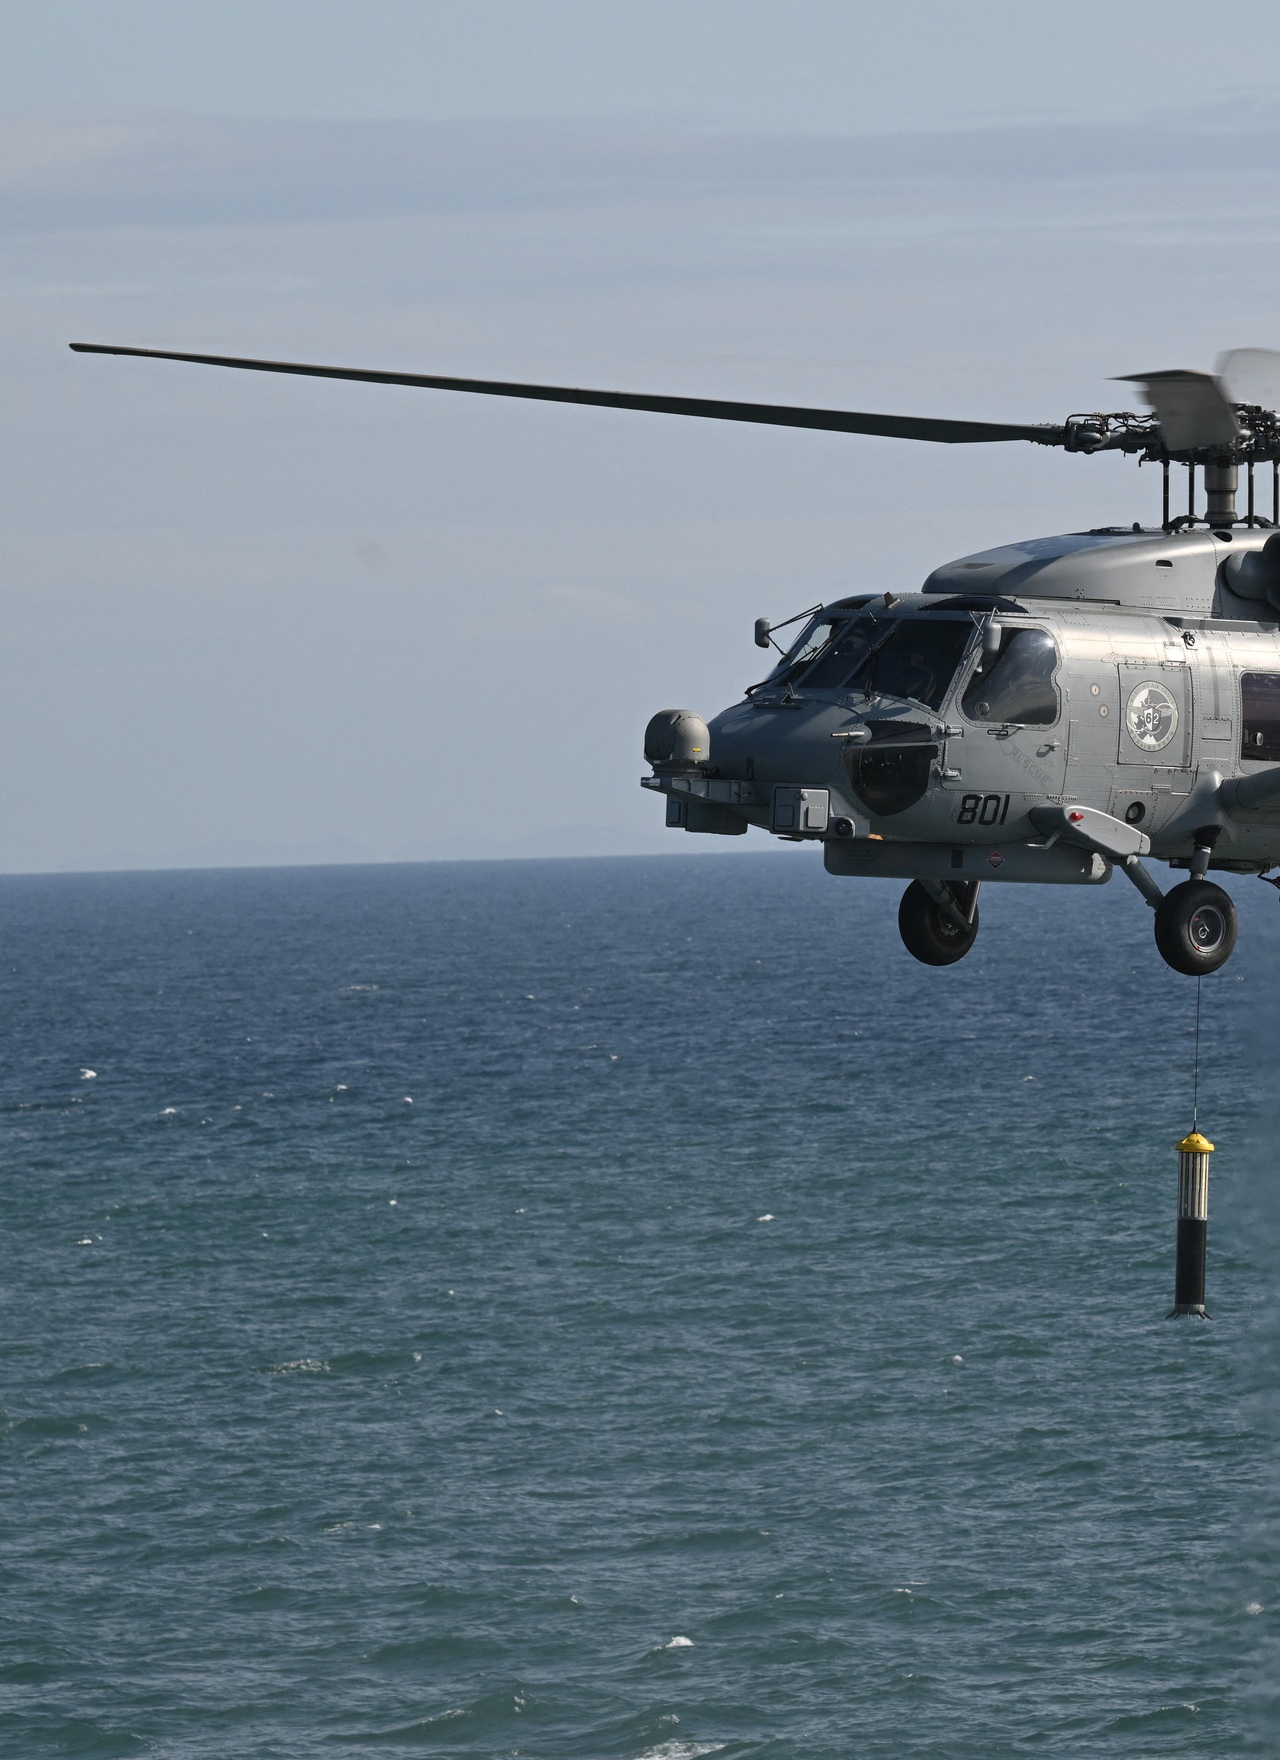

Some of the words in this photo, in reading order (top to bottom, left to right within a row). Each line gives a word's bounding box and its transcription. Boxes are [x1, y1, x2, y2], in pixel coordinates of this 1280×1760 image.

[1145, 712, 1159, 724] 62
[1010, 747, 1049, 786] RESCUE
[957, 794, 1010, 825] 801
